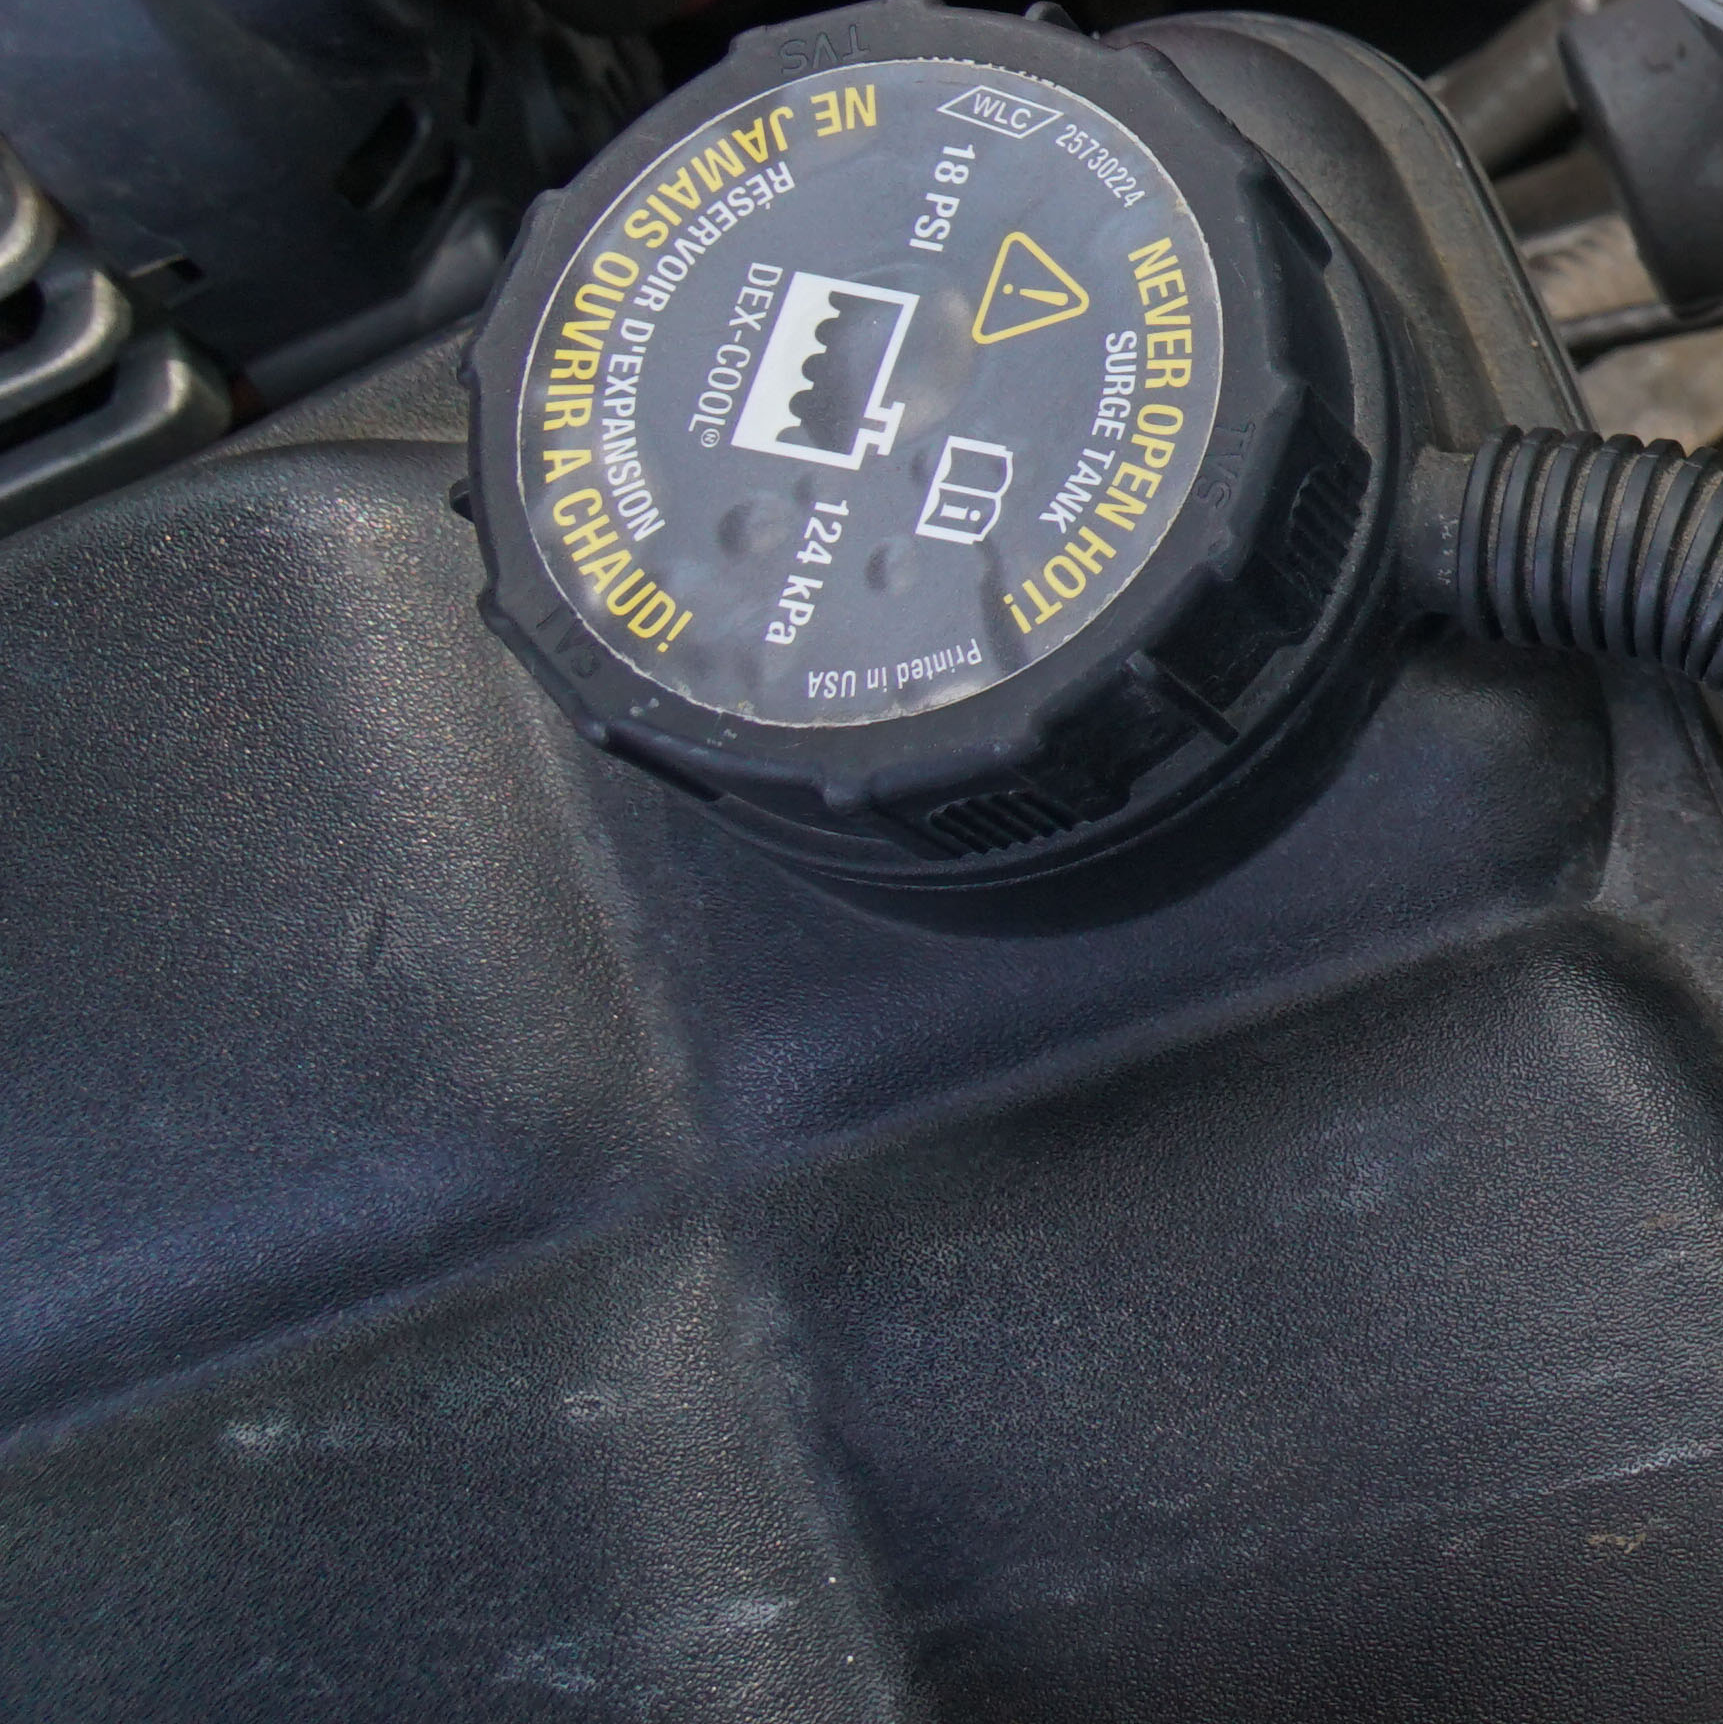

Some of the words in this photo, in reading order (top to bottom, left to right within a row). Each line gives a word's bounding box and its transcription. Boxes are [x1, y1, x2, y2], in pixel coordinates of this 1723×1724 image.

[778, 24, 871, 75] TVS
[810, 84, 878, 137] NE
[973, 92, 1033, 130] WLC
[623, 106, 794, 249] JAMAIS
[934, 143, 976, 185] 18
[1056, 123, 1146, 208] 25730224
[633, 161, 796, 312] RÉSERVOIR
[909, 192, 960, 252] PSI
[543, 251, 640, 431] OUVRIR
[1128, 237, 1193, 389] NEVER
[1092, 330, 1138, 442] SURGE
[543, 449, 592, 484] A
[601, 317, 666, 542] D'EXPANSION
[1094, 403, 1184, 532] OPEN
[1039, 447, 1116, 534] TANK
[552, 488, 693, 653] CHAUD!
[796, 499, 849, 565] 124
[765, 575, 824, 646] kPa
[1003, 525, 1117, 634] HOT!
[808, 669, 856, 699] USA
[866, 665, 888, 692] in
[897, 637, 983, 689] Printed
